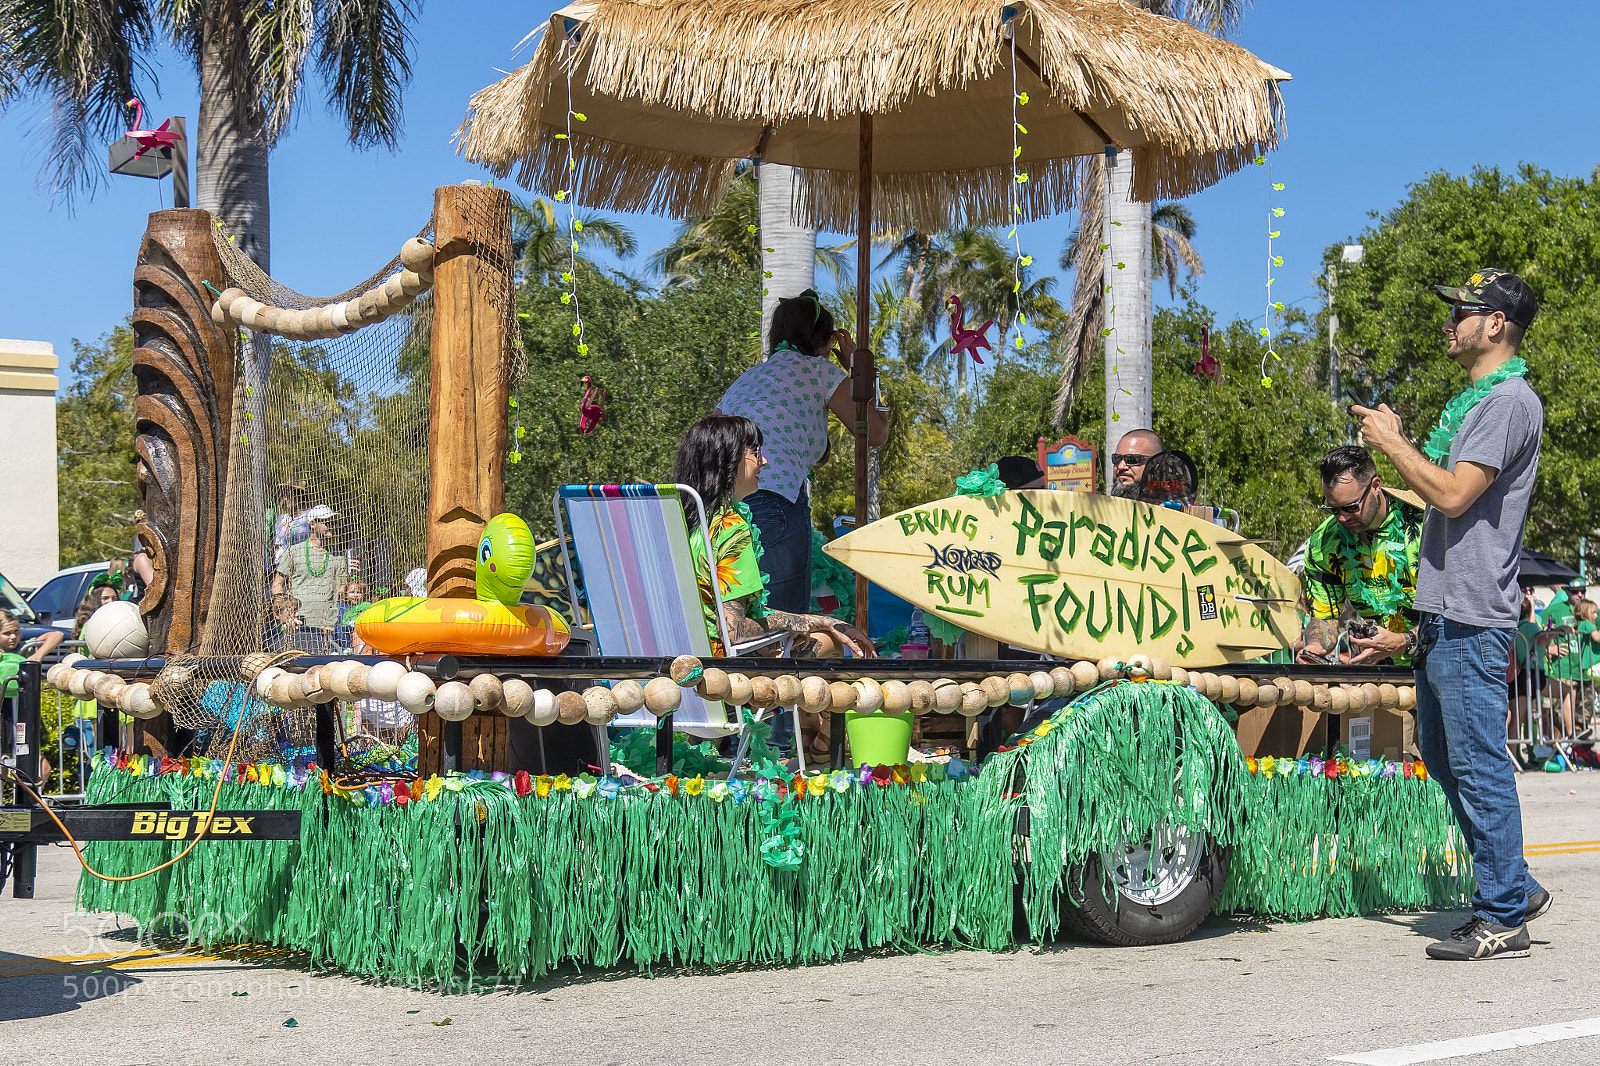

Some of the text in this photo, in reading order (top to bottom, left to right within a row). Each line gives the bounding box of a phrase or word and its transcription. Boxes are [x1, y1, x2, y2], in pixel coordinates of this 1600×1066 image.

[895, 508, 978, 541] BRING
[1012, 491, 1218, 576] Paradise
[921, 542, 1002, 581] NOMAD
[1229, 555, 1272, 579] TELL
[923, 569, 991, 608] RUM
[1226, 575, 1271, 598] MOM
[1017, 572, 1196, 658] FOUND!
[1201, 602, 1215, 614] DB
[1250, 609, 1275, 636] OK
